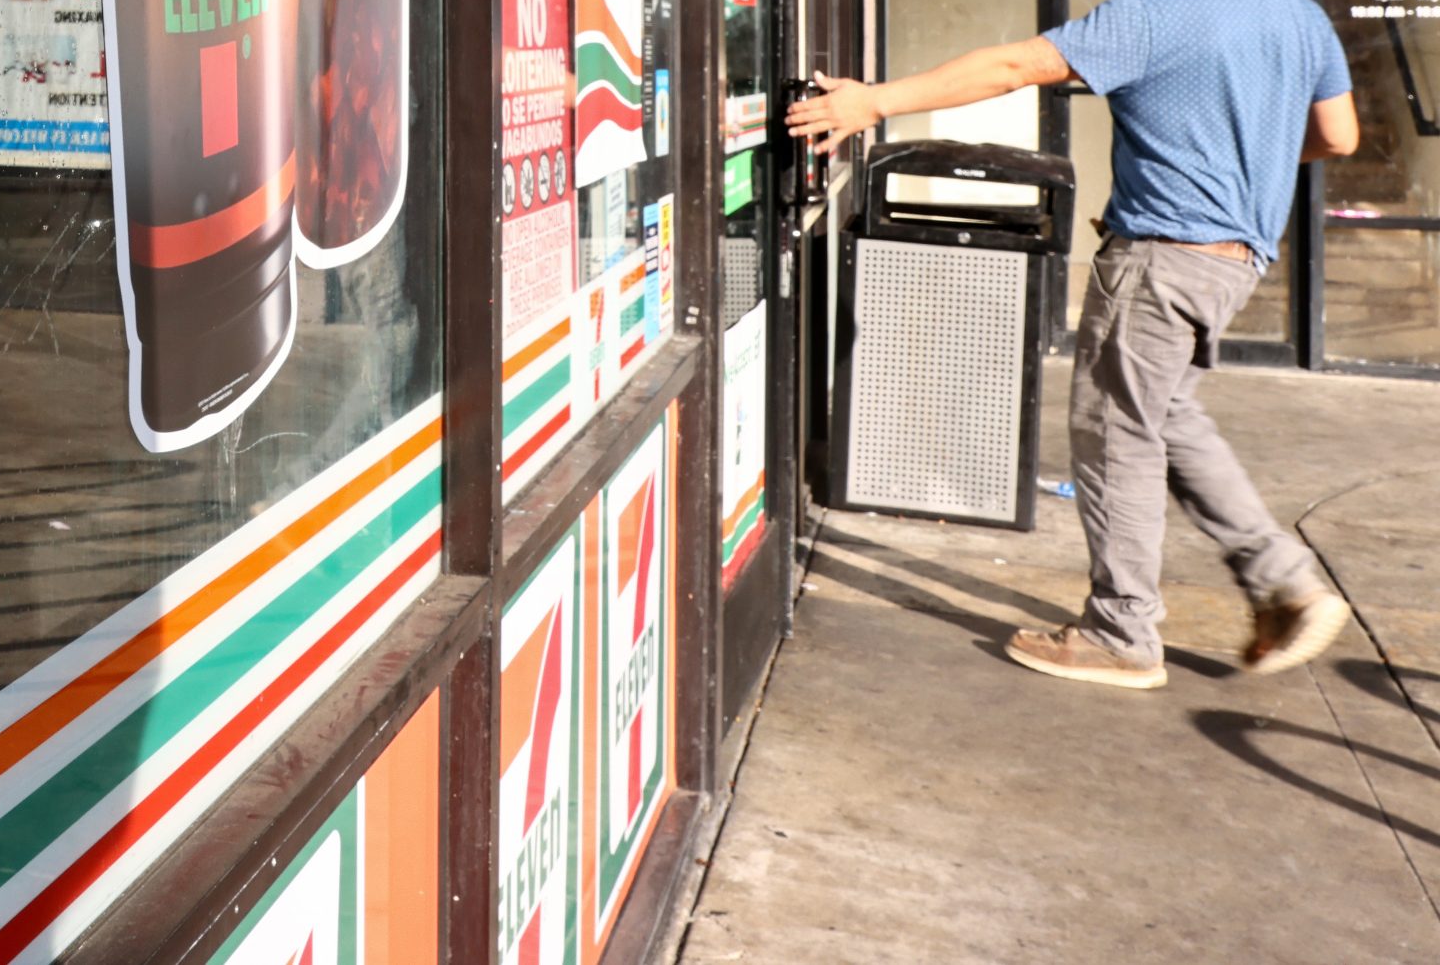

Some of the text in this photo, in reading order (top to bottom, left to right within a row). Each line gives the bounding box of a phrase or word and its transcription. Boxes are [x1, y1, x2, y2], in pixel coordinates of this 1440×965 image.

[502, 47, 566, 94] OITERING
[512, 95, 526, 125] SE
[527, 89, 565, 123] PERMITE
